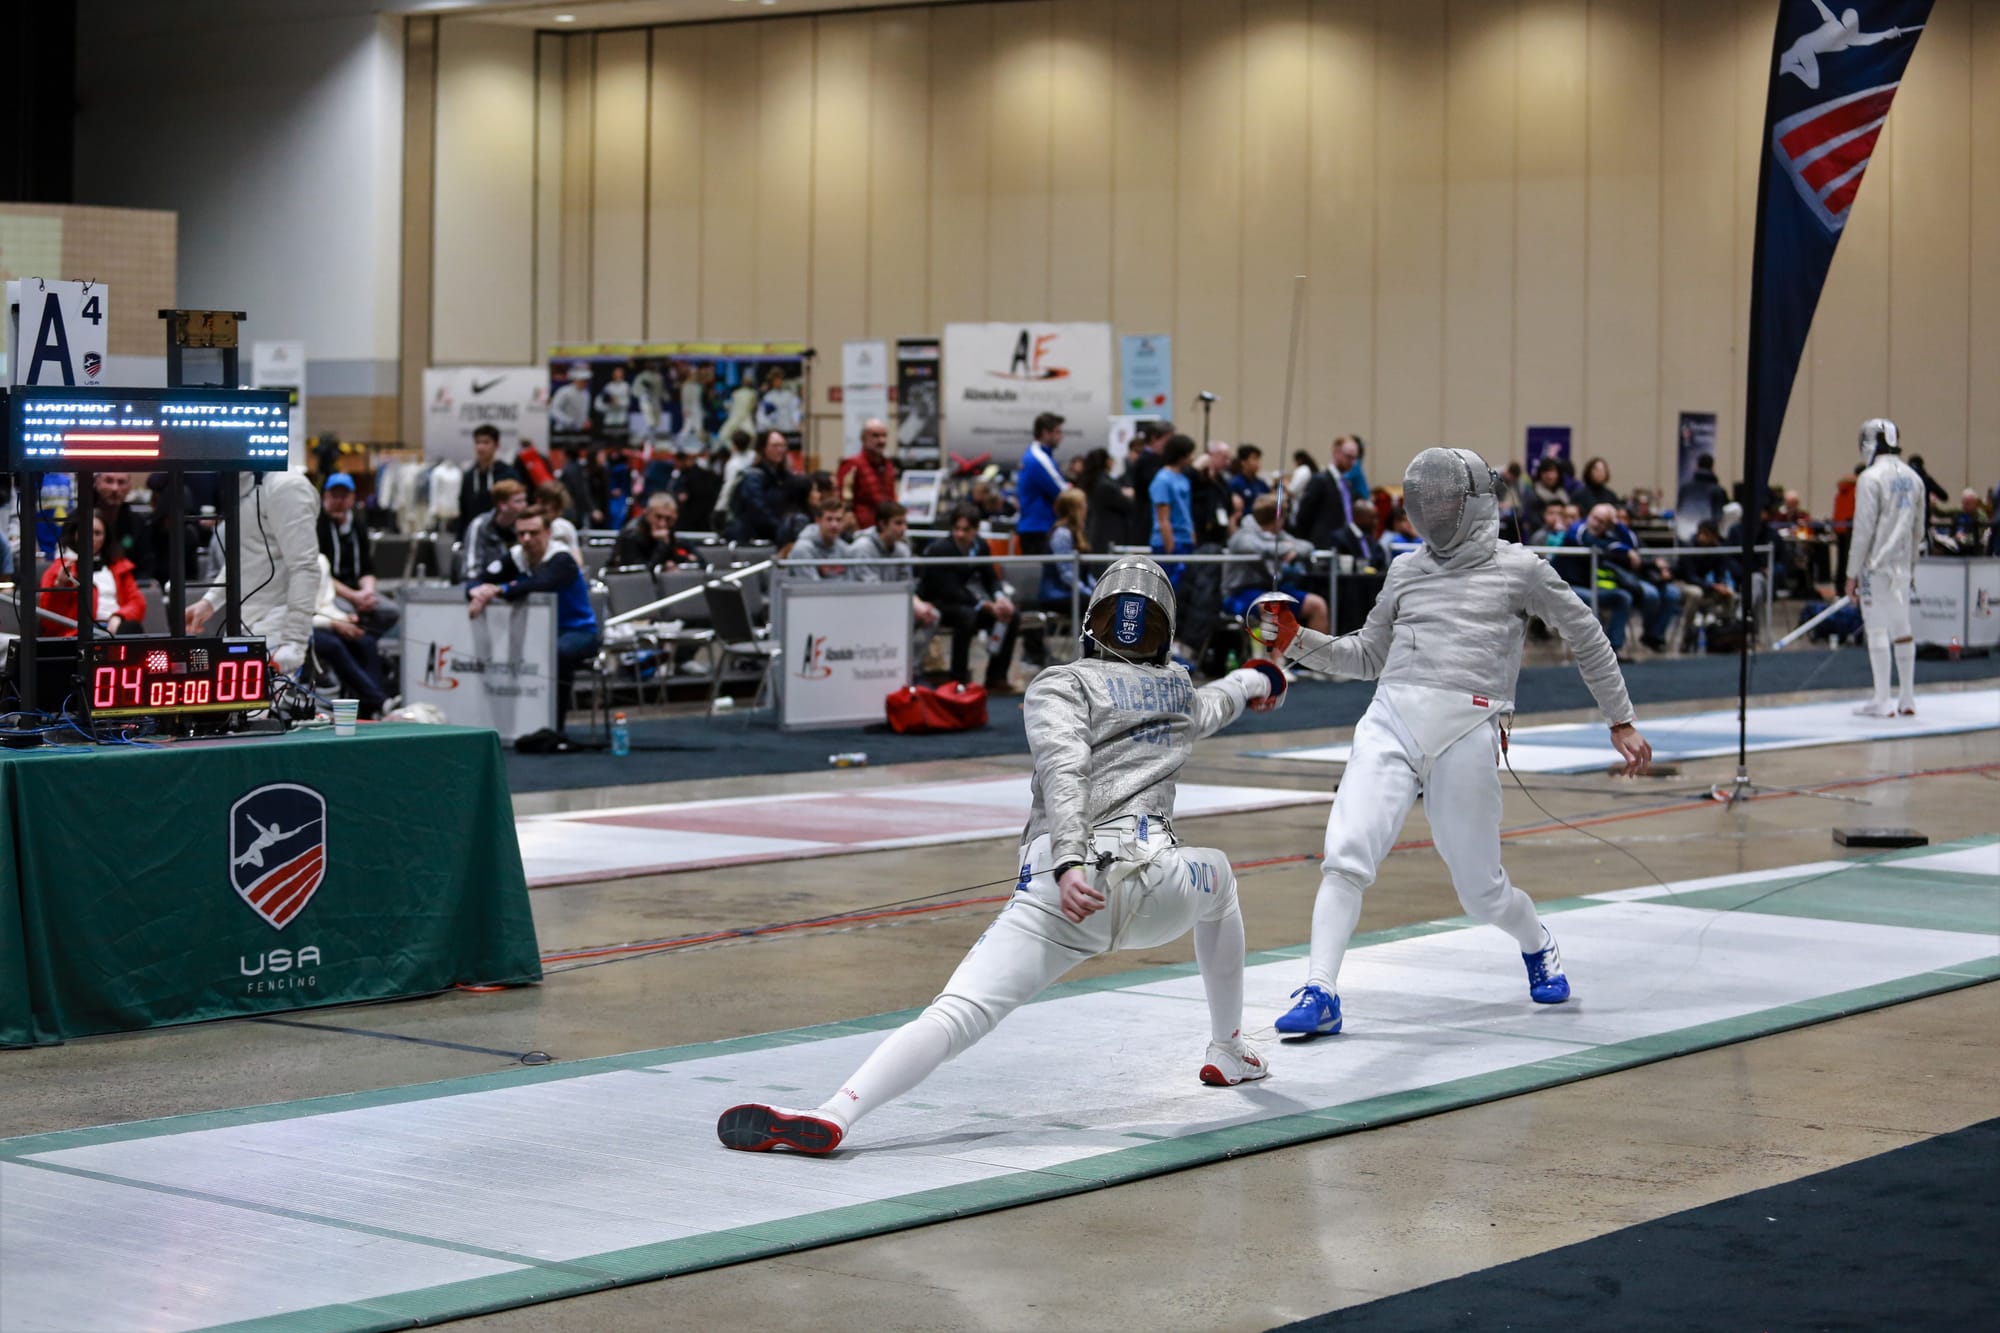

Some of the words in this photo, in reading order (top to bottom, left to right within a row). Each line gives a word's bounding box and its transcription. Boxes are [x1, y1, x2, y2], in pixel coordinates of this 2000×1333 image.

[82, 296, 102, 325] 4
[26, 293, 75, 386] A
[94, 666, 142, 708] 04
[150, 680, 210, 706] 03:00
[216, 660, 263, 701] 00
[240, 946, 320, 976] USA
[247, 976, 317, 994] FENCING
